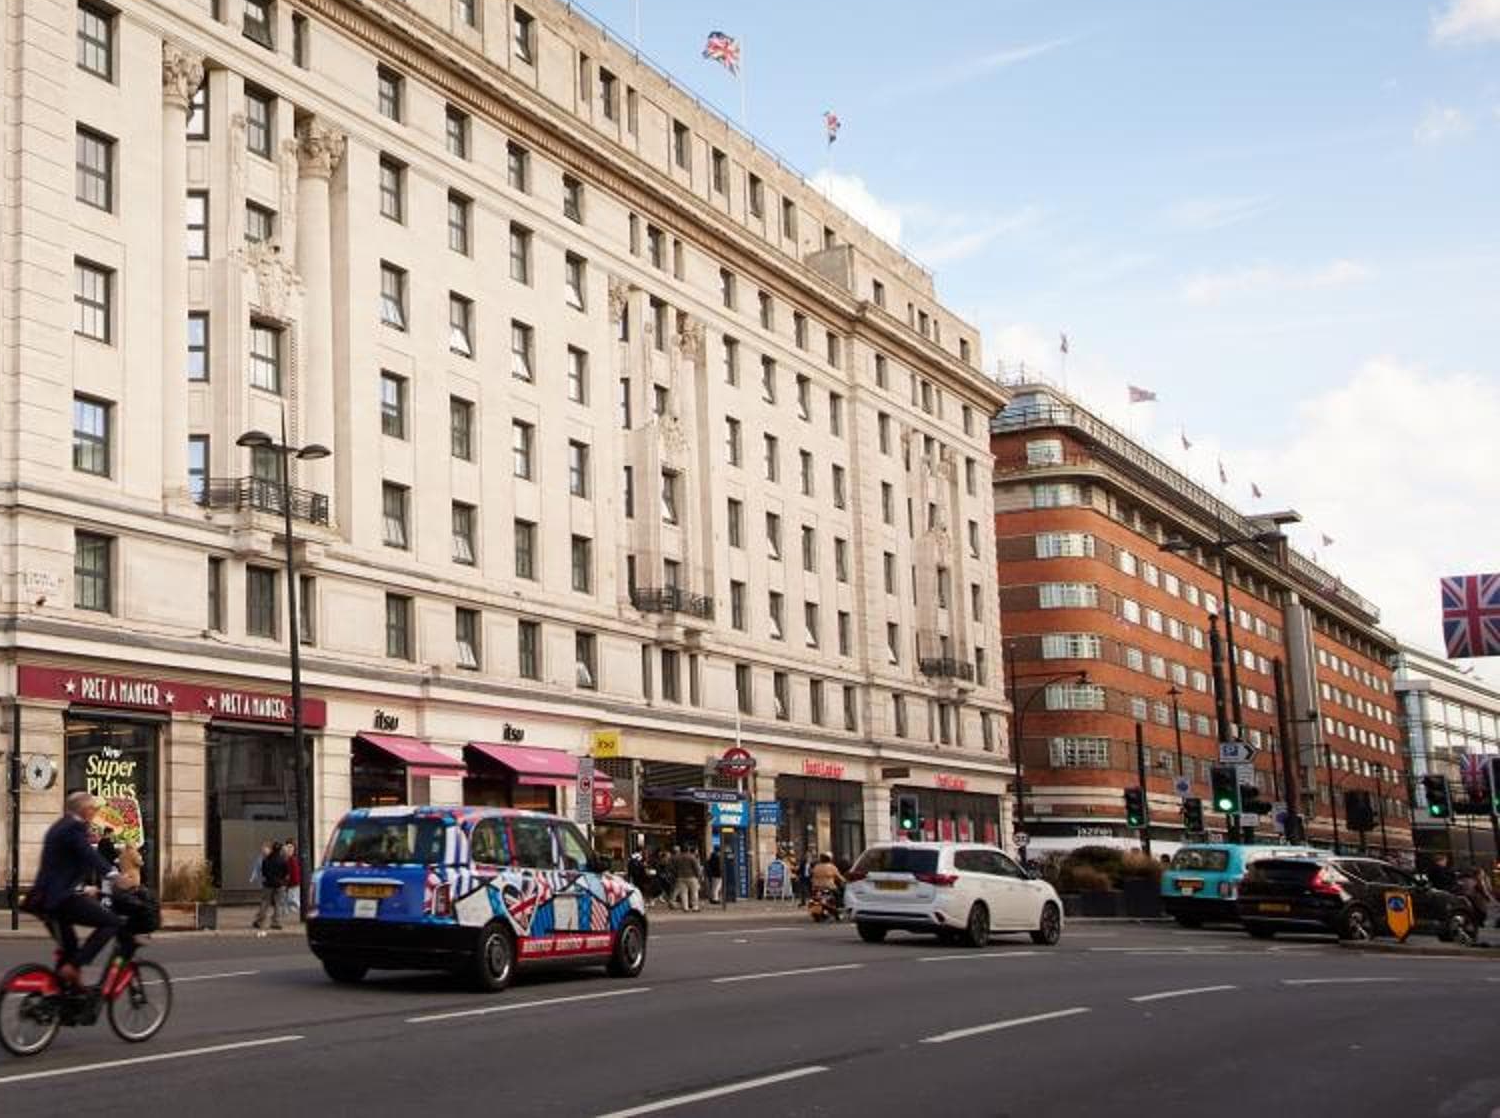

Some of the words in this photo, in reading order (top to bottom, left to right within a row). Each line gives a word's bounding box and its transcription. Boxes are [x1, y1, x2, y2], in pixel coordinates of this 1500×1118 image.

[81, 677, 107, 700] PRET
[109, 680, 118, 701] A
[119, 681, 160, 705] MANGER
[219, 693, 242, 714] PRET
[243, 695, 251, 715] A
[373, 709, 399, 731] itsu
[502, 723, 525, 742] itsu
[86, 754, 137, 781] Super
[86, 778, 137, 801] Plates
